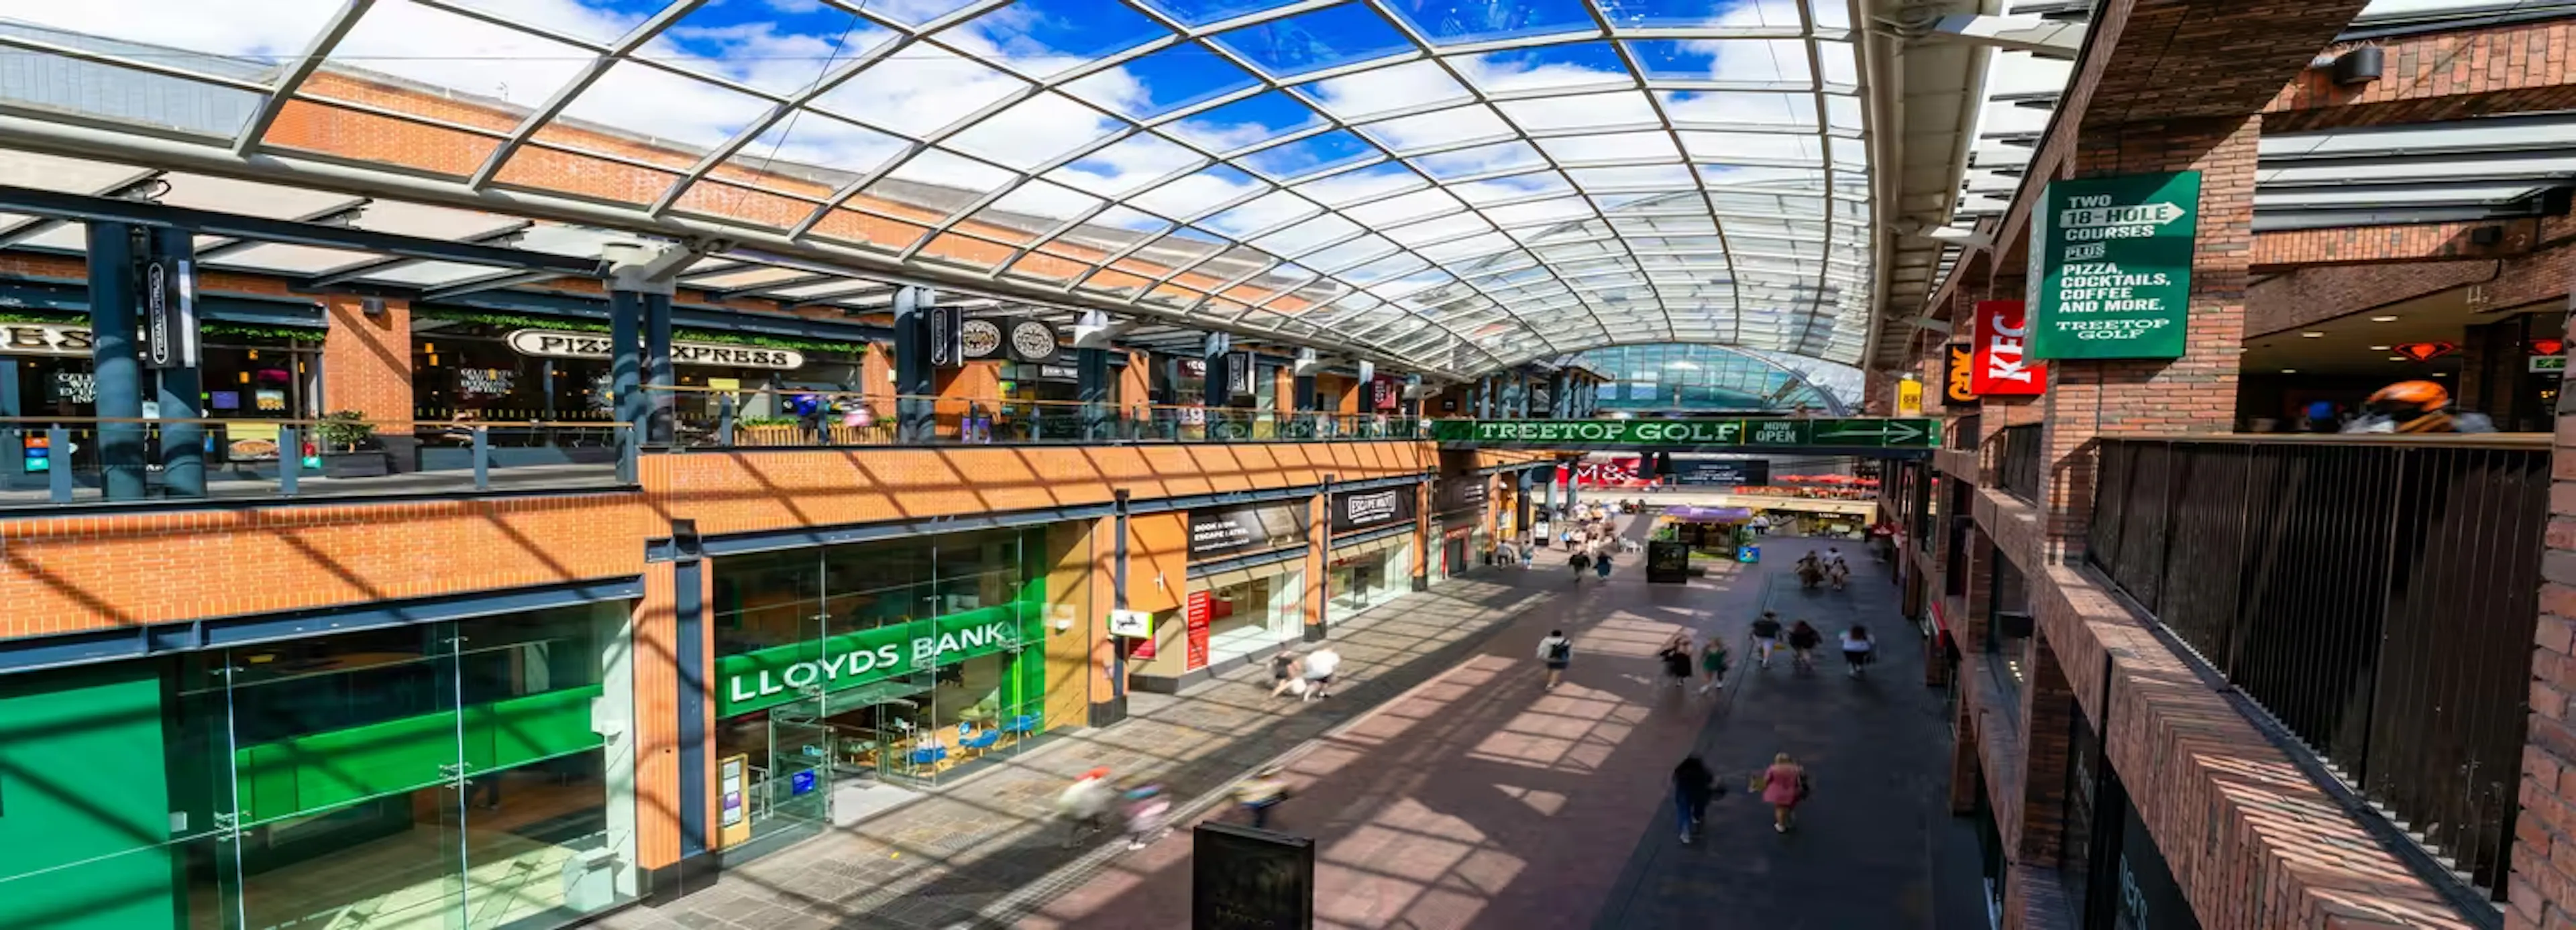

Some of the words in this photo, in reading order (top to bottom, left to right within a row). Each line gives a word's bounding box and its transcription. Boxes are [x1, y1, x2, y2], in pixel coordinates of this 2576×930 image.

[2068, 194, 2112, 209] TWO
[2068, 206, 2169, 225] 18-HOLE
[2065, 225, 2155, 241] COURSES
[2065, 244, 2105, 259] PLUS
[2061, 273, 2171, 288] COCKTAILS,
[2060, 286, 2133, 300] COFFEE
[2058, 301, 2098, 313] AND
[2104, 298, 2165, 312] MORE.
[2056, 318, 2170, 331] TREETOP
[2078, 329, 2145, 340] GOLF
[672, 345, 788, 365] XPRESS
[1988, 314, 2031, 384] KFC
[1480, 422, 1627, 440] TREETOP
[1635, 423, 1740, 441] GOLF
[1763, 422, 1791, 430] NOW
[1756, 430, 1796, 443] OPEN
[731, 643, 900, 702] LLOYDS
[911, 620, 1008, 660] BANK
